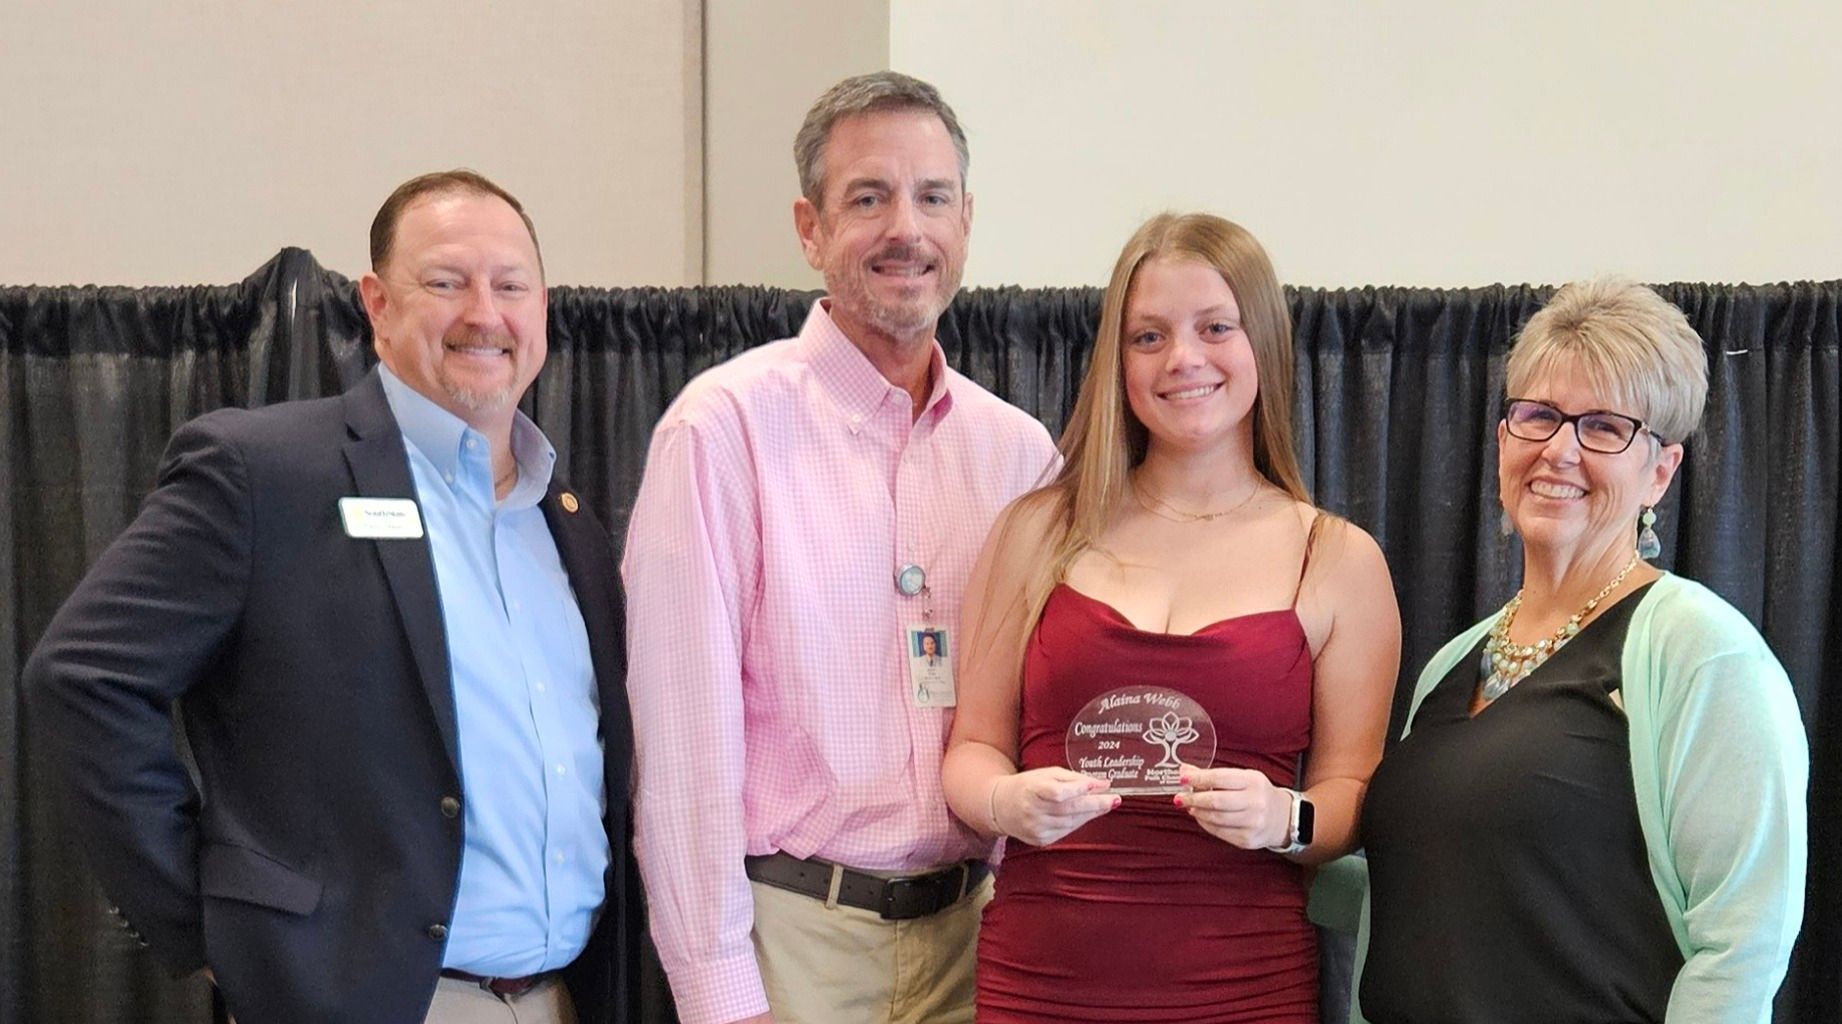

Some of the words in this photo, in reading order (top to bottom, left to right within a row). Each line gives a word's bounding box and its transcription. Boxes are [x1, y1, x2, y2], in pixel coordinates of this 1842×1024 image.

[1098, 693, 1141, 714] Alaina
[1143, 692, 1182, 710] Webb
[1074, 718, 1143, 738] Congratulations
[1098, 740, 1121, 750] 2024
[1079, 755, 1103, 768] Youth
[1103, 754, 1144, 770] Leadership
[1108, 767, 1139, 782] Graduate
